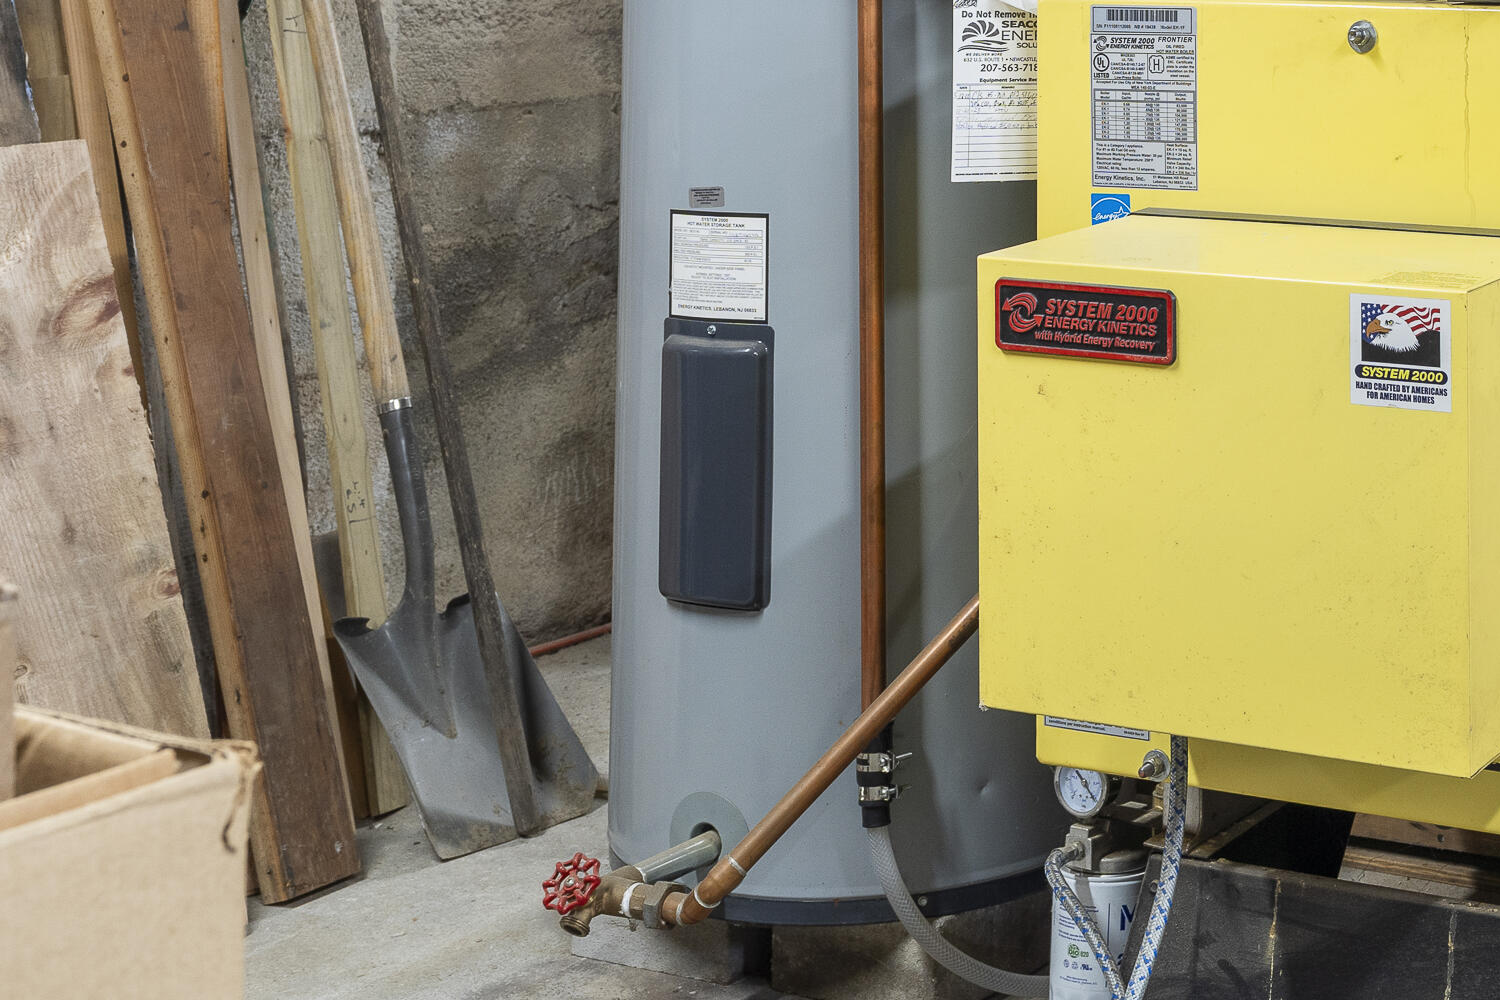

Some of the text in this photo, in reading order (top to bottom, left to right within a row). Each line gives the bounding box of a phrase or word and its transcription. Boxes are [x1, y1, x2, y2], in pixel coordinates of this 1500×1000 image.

[1001, 30, 1037, 40] ENE
[981, 64, 1037, 72] 207-563-718
[1045, 298, 1159, 323] SYSTEM 2000
[1044, 317, 1157, 337] ENERGY KINETICS
[1034, 330, 1155, 352] with Hybrid Energy Recovery
[1361, 366, 1444, 383] SYSTEM 2000
[1356, 381, 1448, 396] HAND CRAFTED BY AMERICANS
[1367, 391, 1434, 404] FOR AMERICAN HOMES
